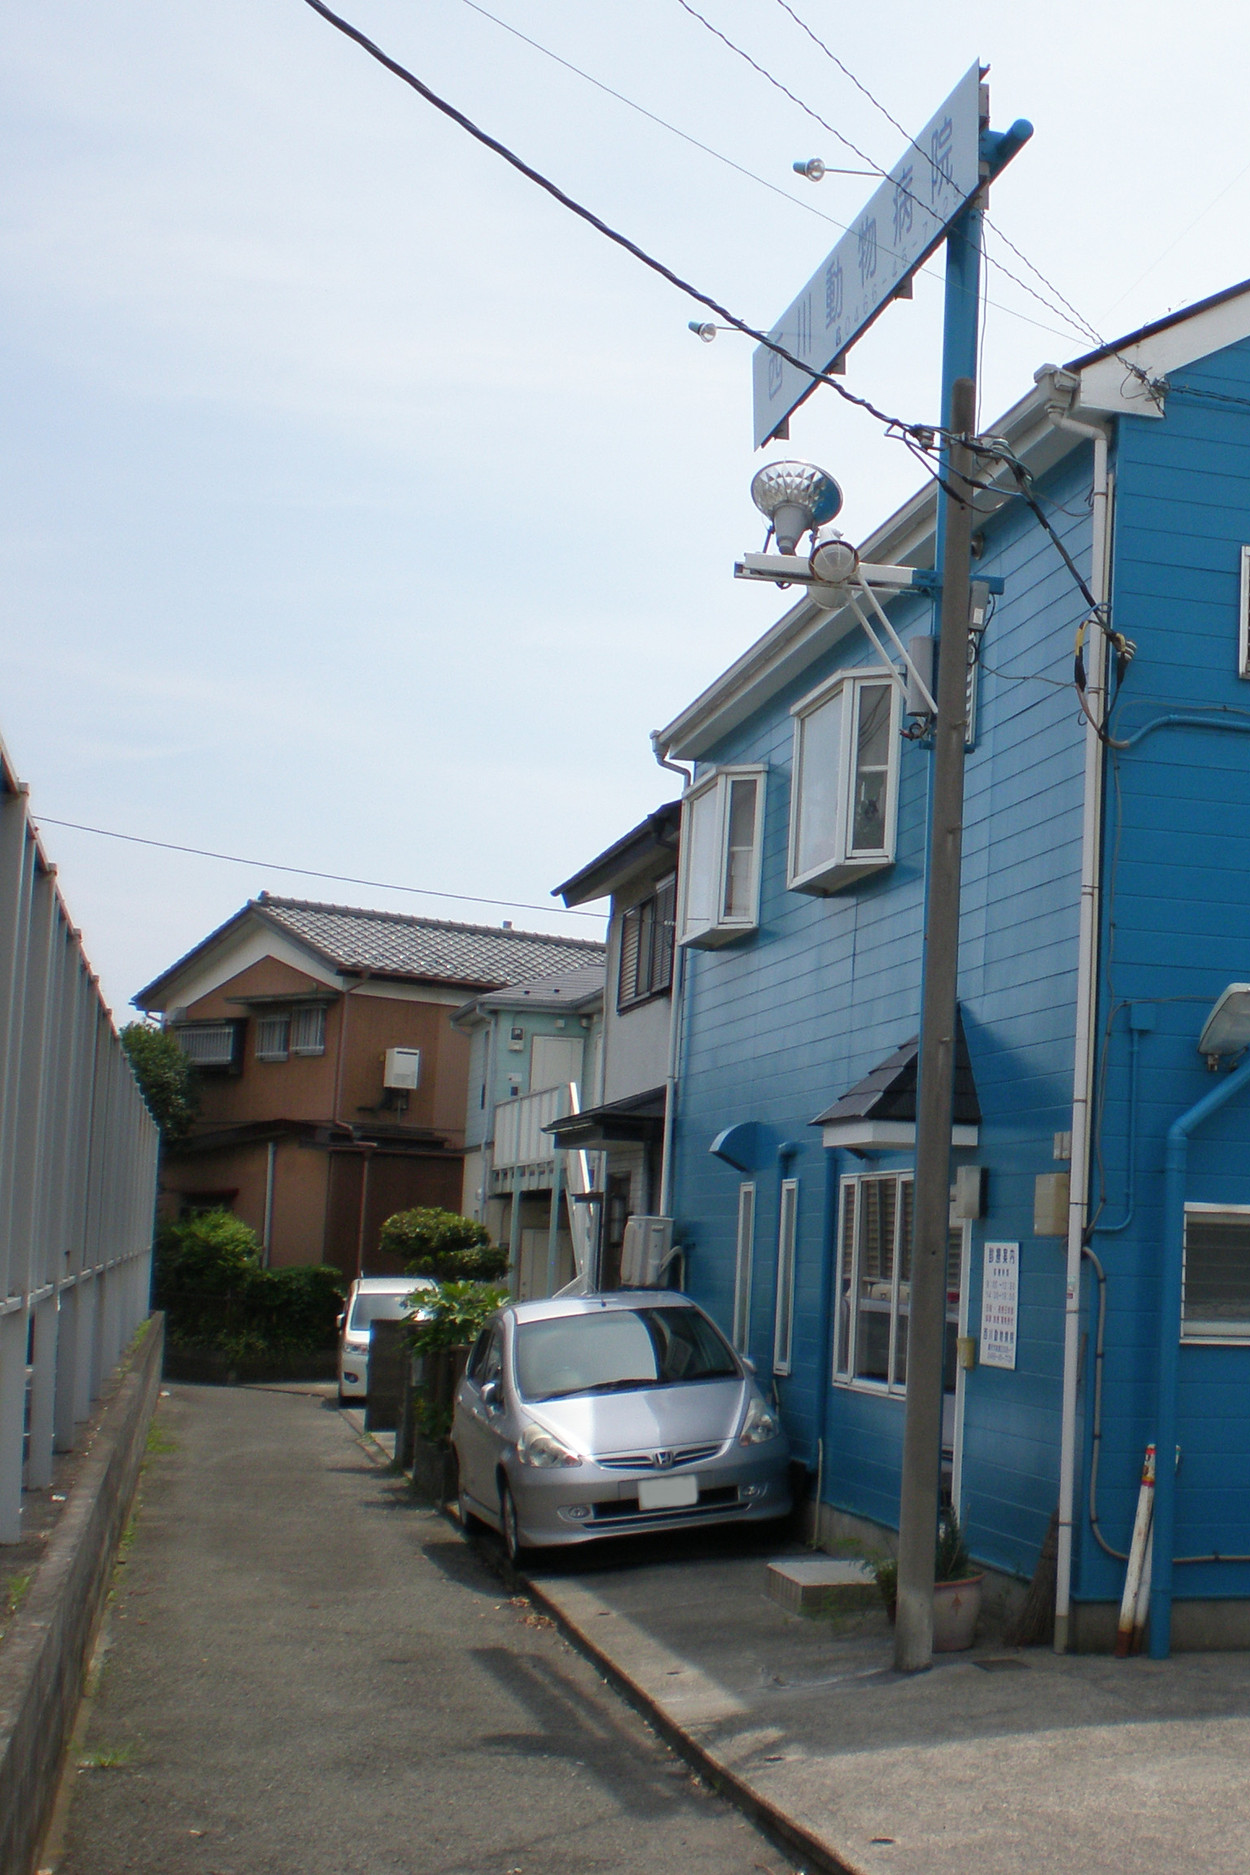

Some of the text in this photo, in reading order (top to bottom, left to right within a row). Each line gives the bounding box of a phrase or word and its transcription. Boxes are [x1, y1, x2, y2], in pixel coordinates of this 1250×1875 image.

[768, 116, 954, 401] 西川動物病院
